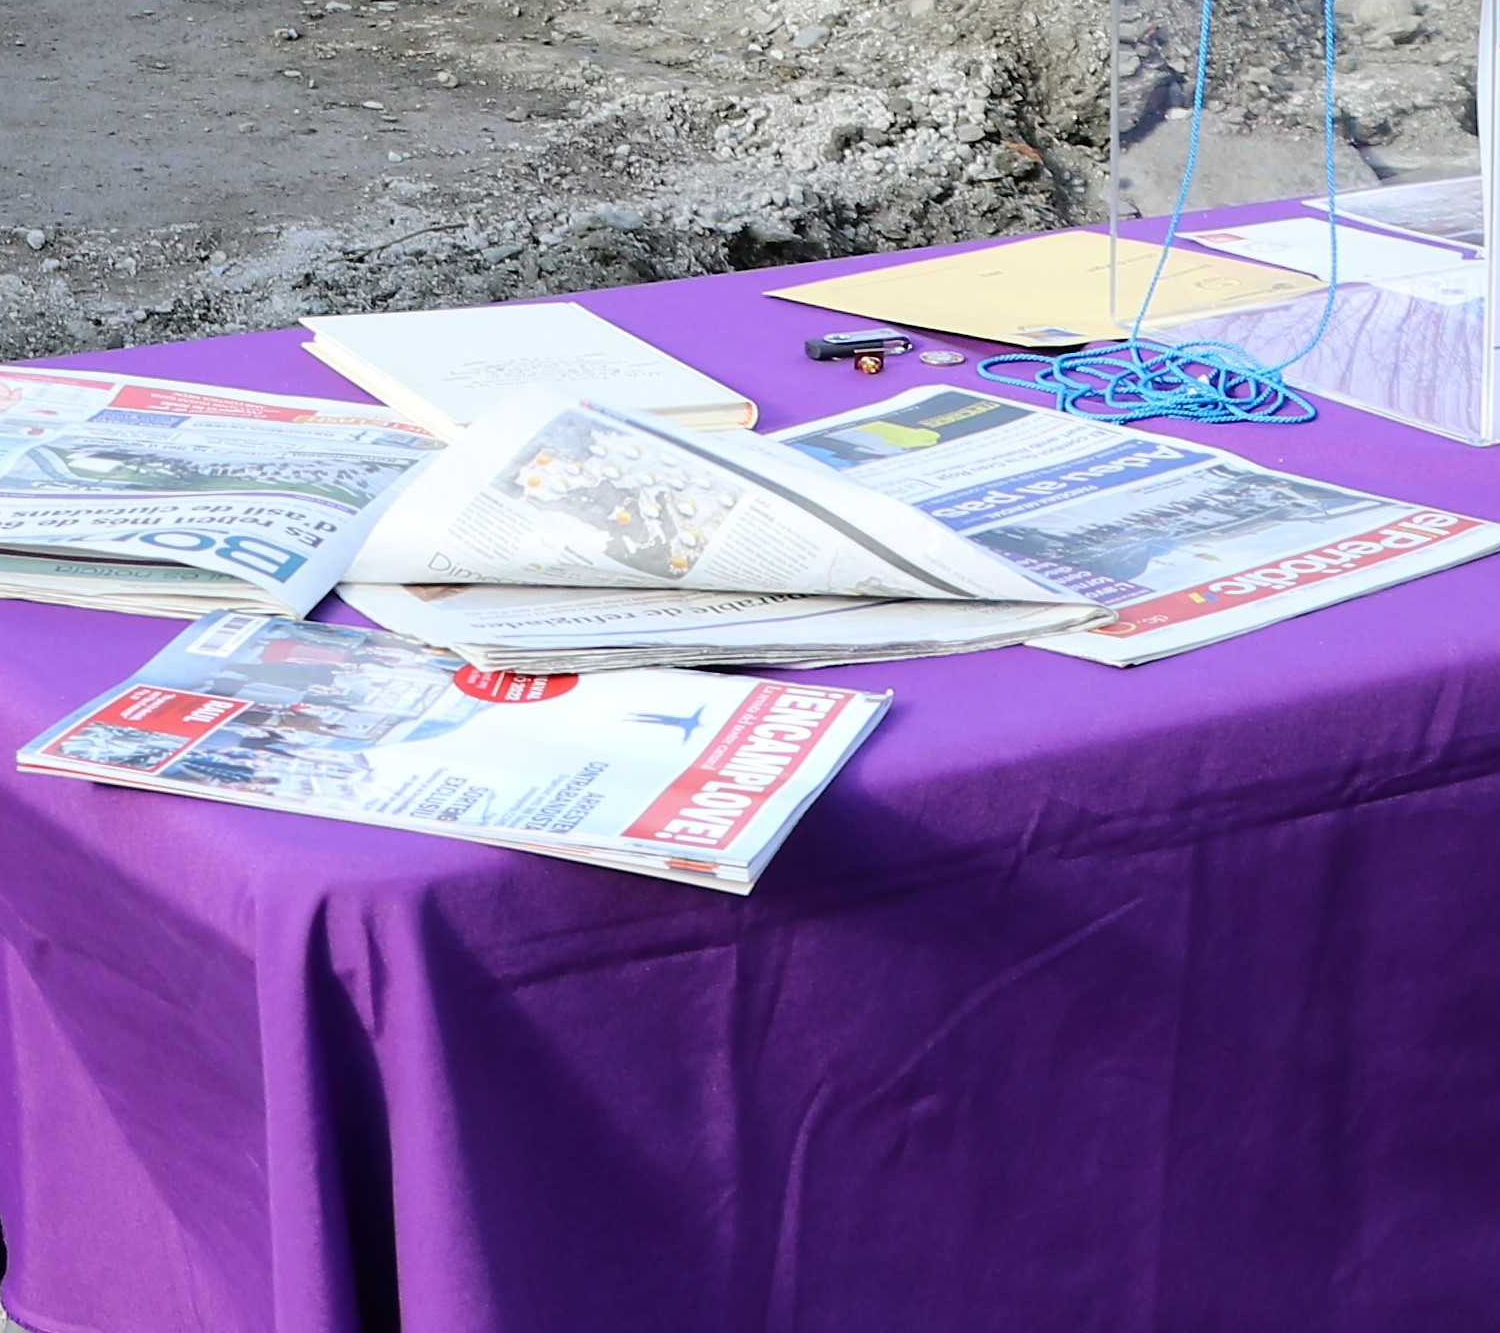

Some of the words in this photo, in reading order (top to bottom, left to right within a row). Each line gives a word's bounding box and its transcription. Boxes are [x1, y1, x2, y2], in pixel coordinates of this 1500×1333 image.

[1059, 444, 1185, 483] Adeu
[1014, 480, 1068, 497] al
[37, 518, 79, 529] de
[283, 526, 324, 549] Es
[1208, 530, 1421, 597] Periòdic
